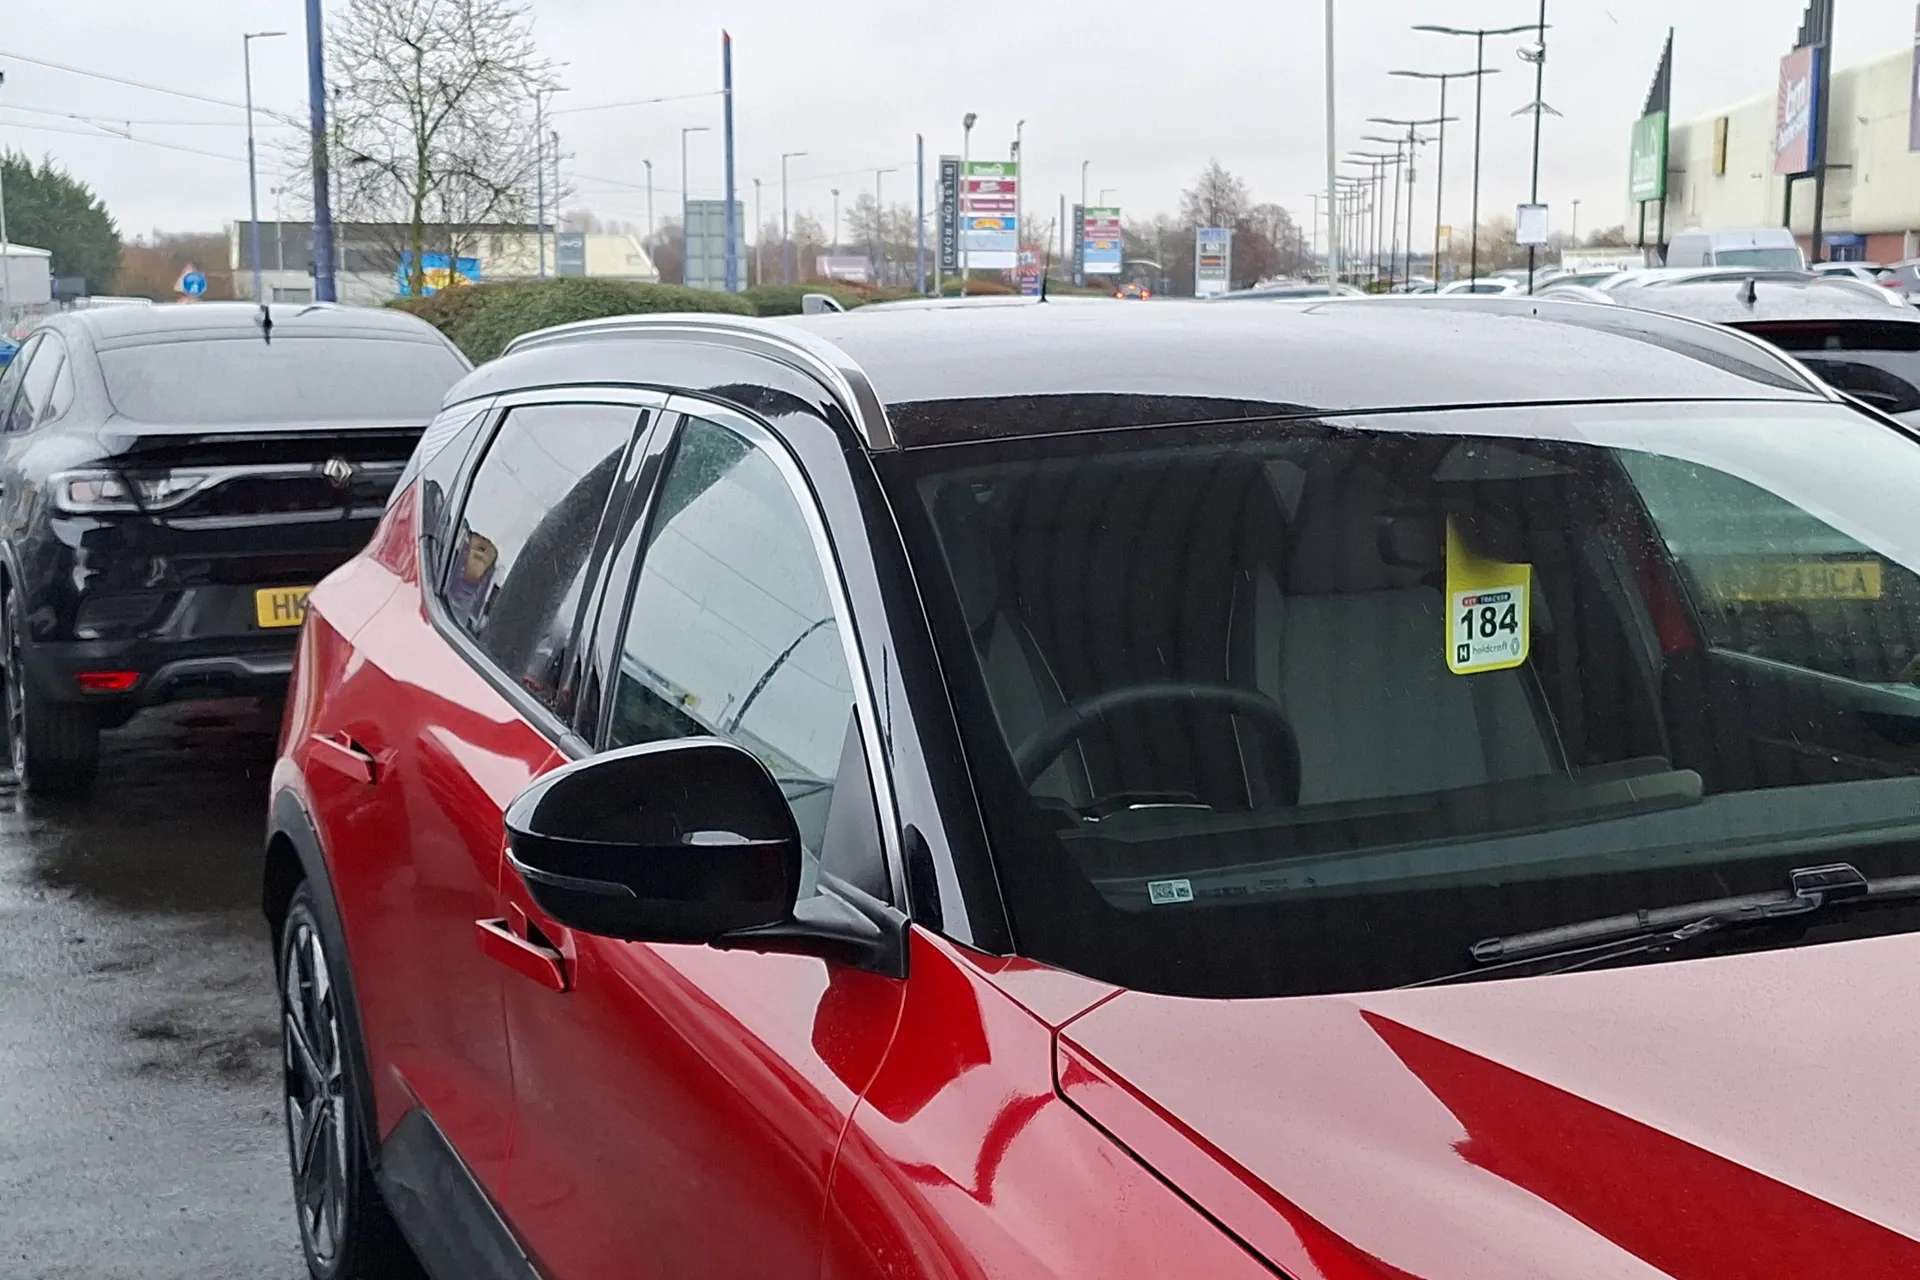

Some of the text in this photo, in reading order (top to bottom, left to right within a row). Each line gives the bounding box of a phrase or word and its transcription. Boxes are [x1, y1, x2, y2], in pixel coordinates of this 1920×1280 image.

[944, 167, 953, 264] BILSTON ROAD
[1464, 594, 1508, 605] KEY TRACKER
[1461, 603, 1518, 640] 184
